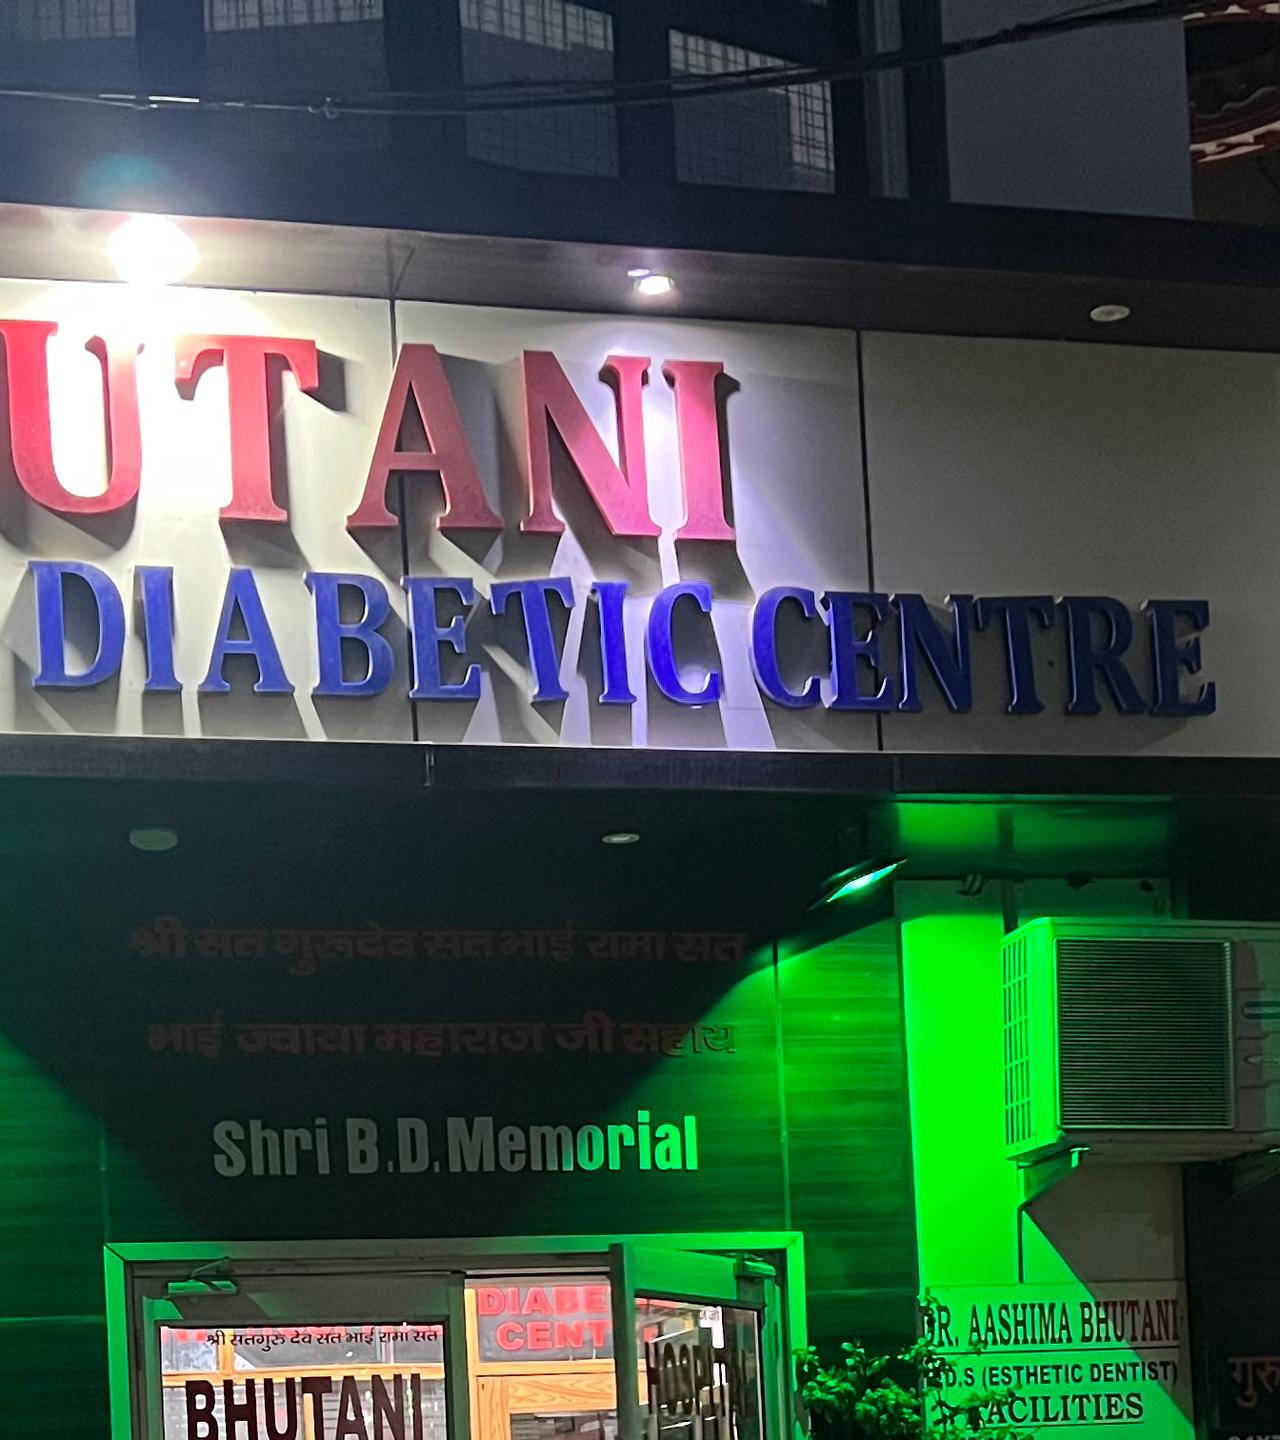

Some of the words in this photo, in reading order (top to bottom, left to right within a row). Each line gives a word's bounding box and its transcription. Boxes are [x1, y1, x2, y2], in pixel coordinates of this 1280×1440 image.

[27, 559, 721, 708] DIABETIC
[749, 586, 1218, 718] CENTRE
[212, 1116, 330, 1176] Shri
[970, 1301, 1073, 1347] AASHIMA
[1080, 1298, 1180, 1344] BHUTANI
[981, 1363, 1085, 1391] (ESTHETIC
[1089, 1359, 1179, 1386] DENTIST)
